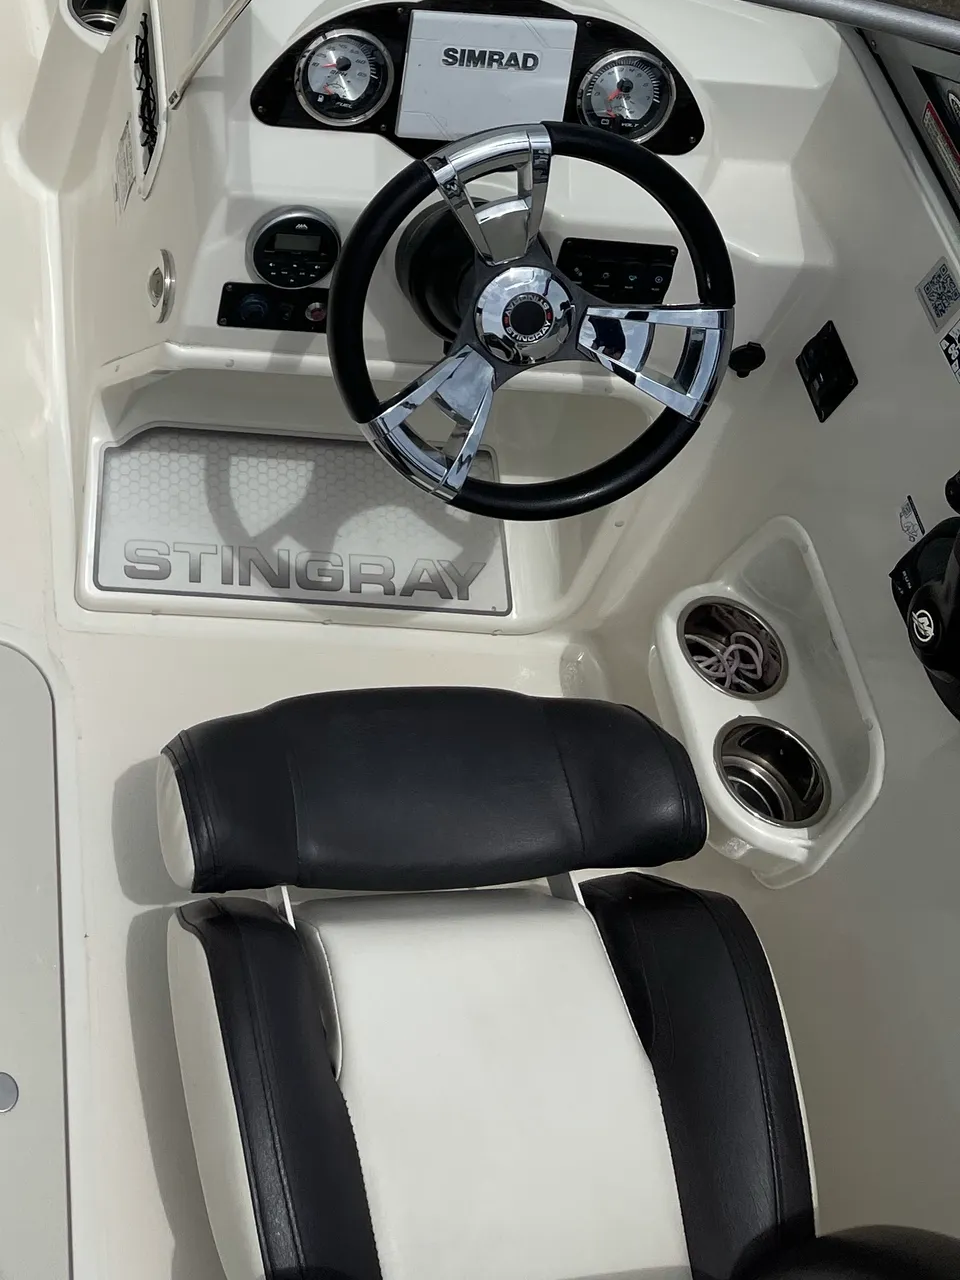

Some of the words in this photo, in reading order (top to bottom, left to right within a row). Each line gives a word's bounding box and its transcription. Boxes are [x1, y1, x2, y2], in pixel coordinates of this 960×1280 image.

[442, 47, 539, 71] SIMRAD
[505, 320, 551, 342] STINGRAY
[124, 539, 487, 601] STINGRAY
